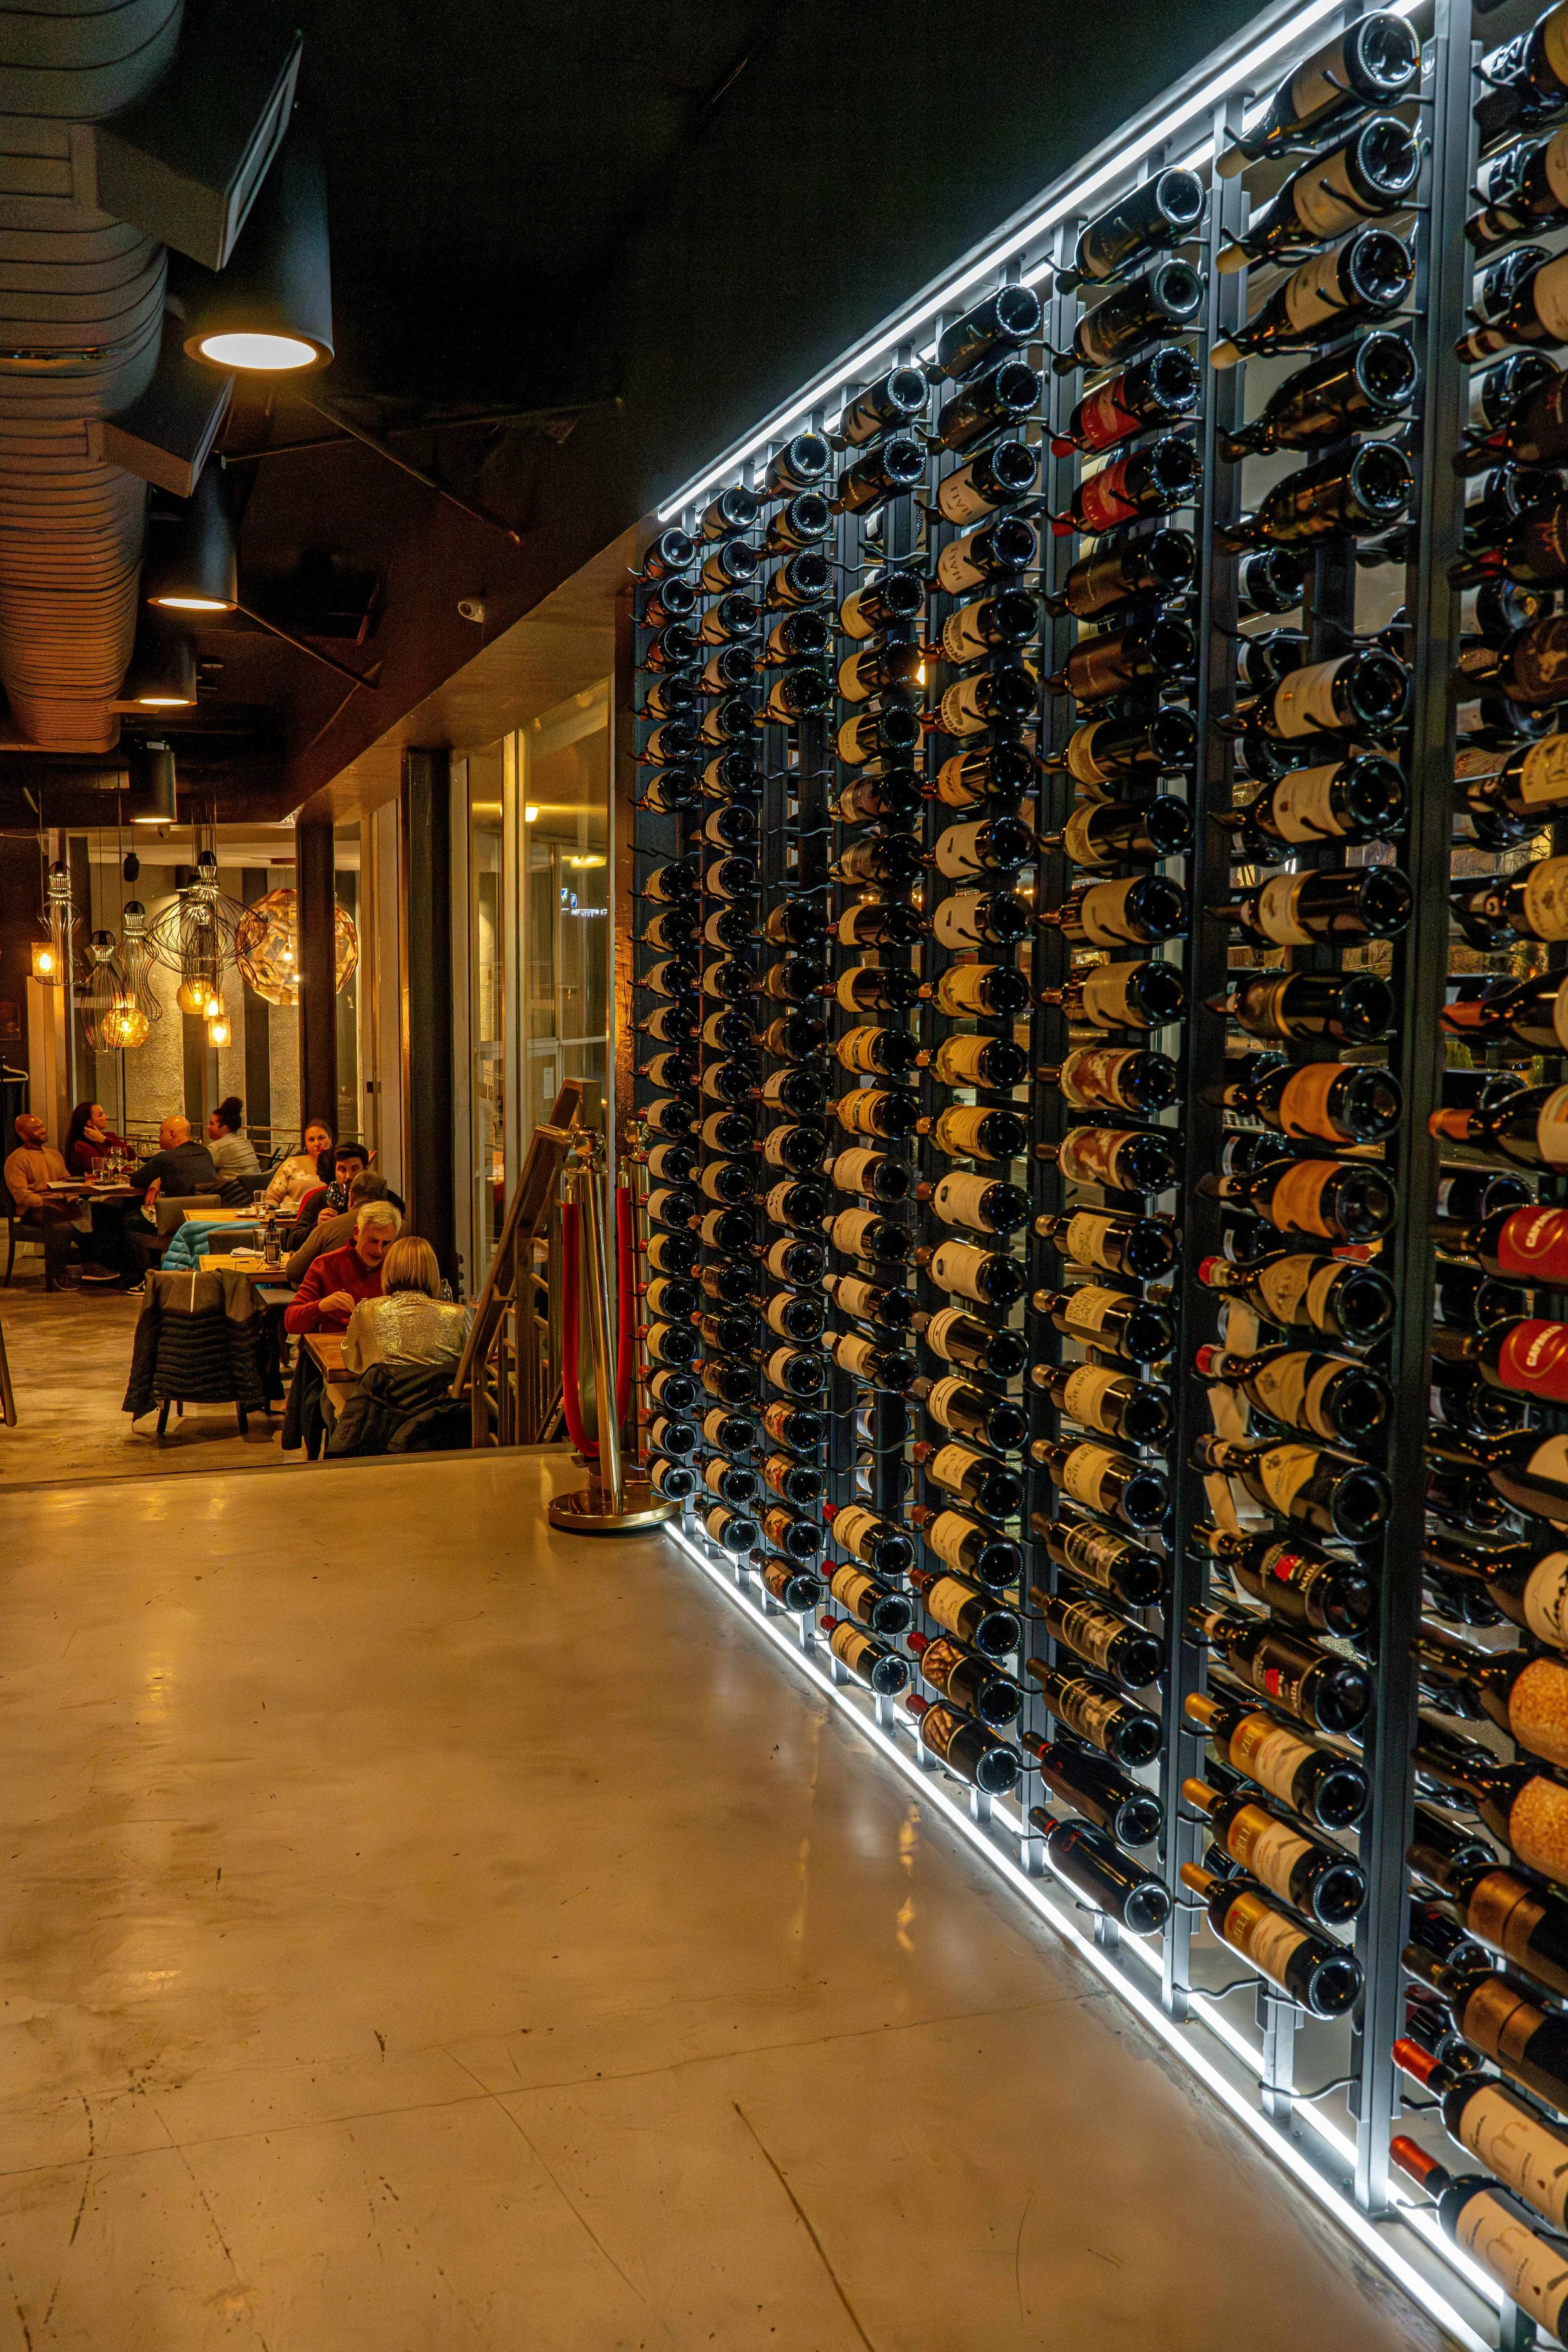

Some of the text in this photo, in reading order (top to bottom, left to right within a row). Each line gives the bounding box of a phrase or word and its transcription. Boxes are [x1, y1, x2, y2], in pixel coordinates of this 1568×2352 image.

[950, 484, 973, 517] HALL
[949, 546, 963, 581] HALL
[1298, 1563, 1320, 1592] NADA
